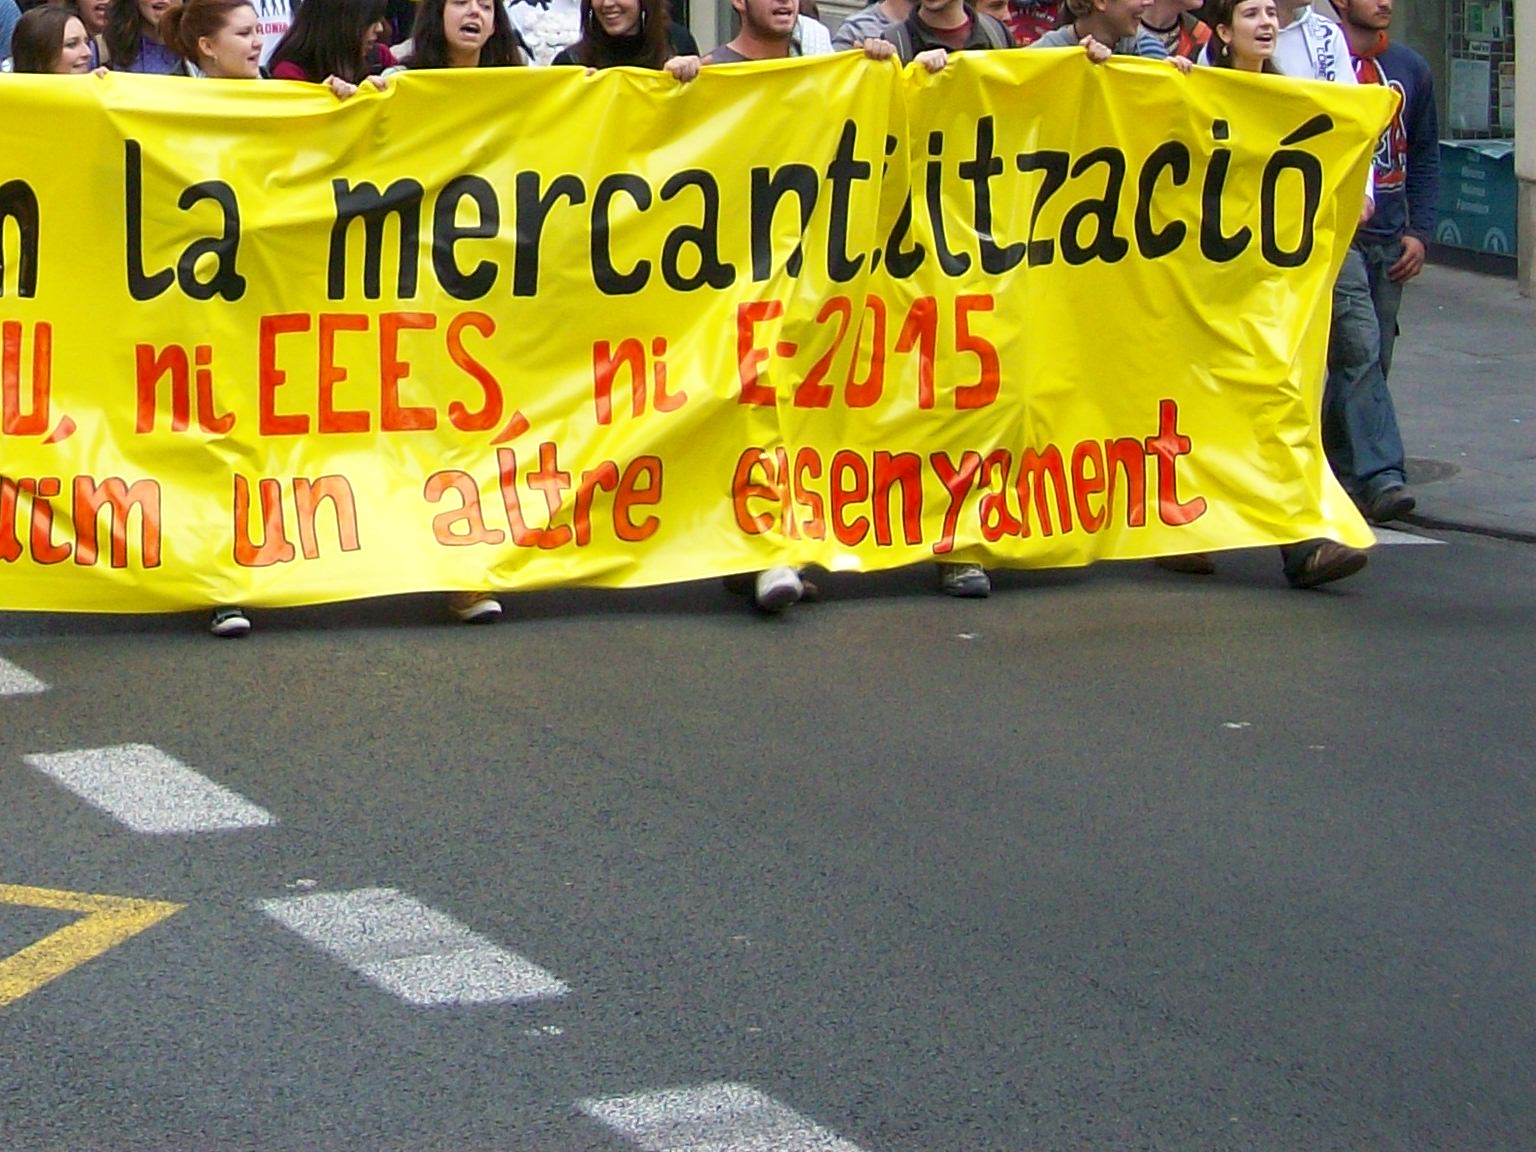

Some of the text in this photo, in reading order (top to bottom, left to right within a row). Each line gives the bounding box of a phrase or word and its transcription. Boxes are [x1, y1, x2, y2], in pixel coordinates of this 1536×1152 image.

[124, 138, 247, 303] la
[134, 343, 236, 436] ni
[591, 335, 689, 426] ni
[736, 293, 1001, 411] E-2015
[232, 472, 362, 567] un
[422, 441, 664, 550] altre
